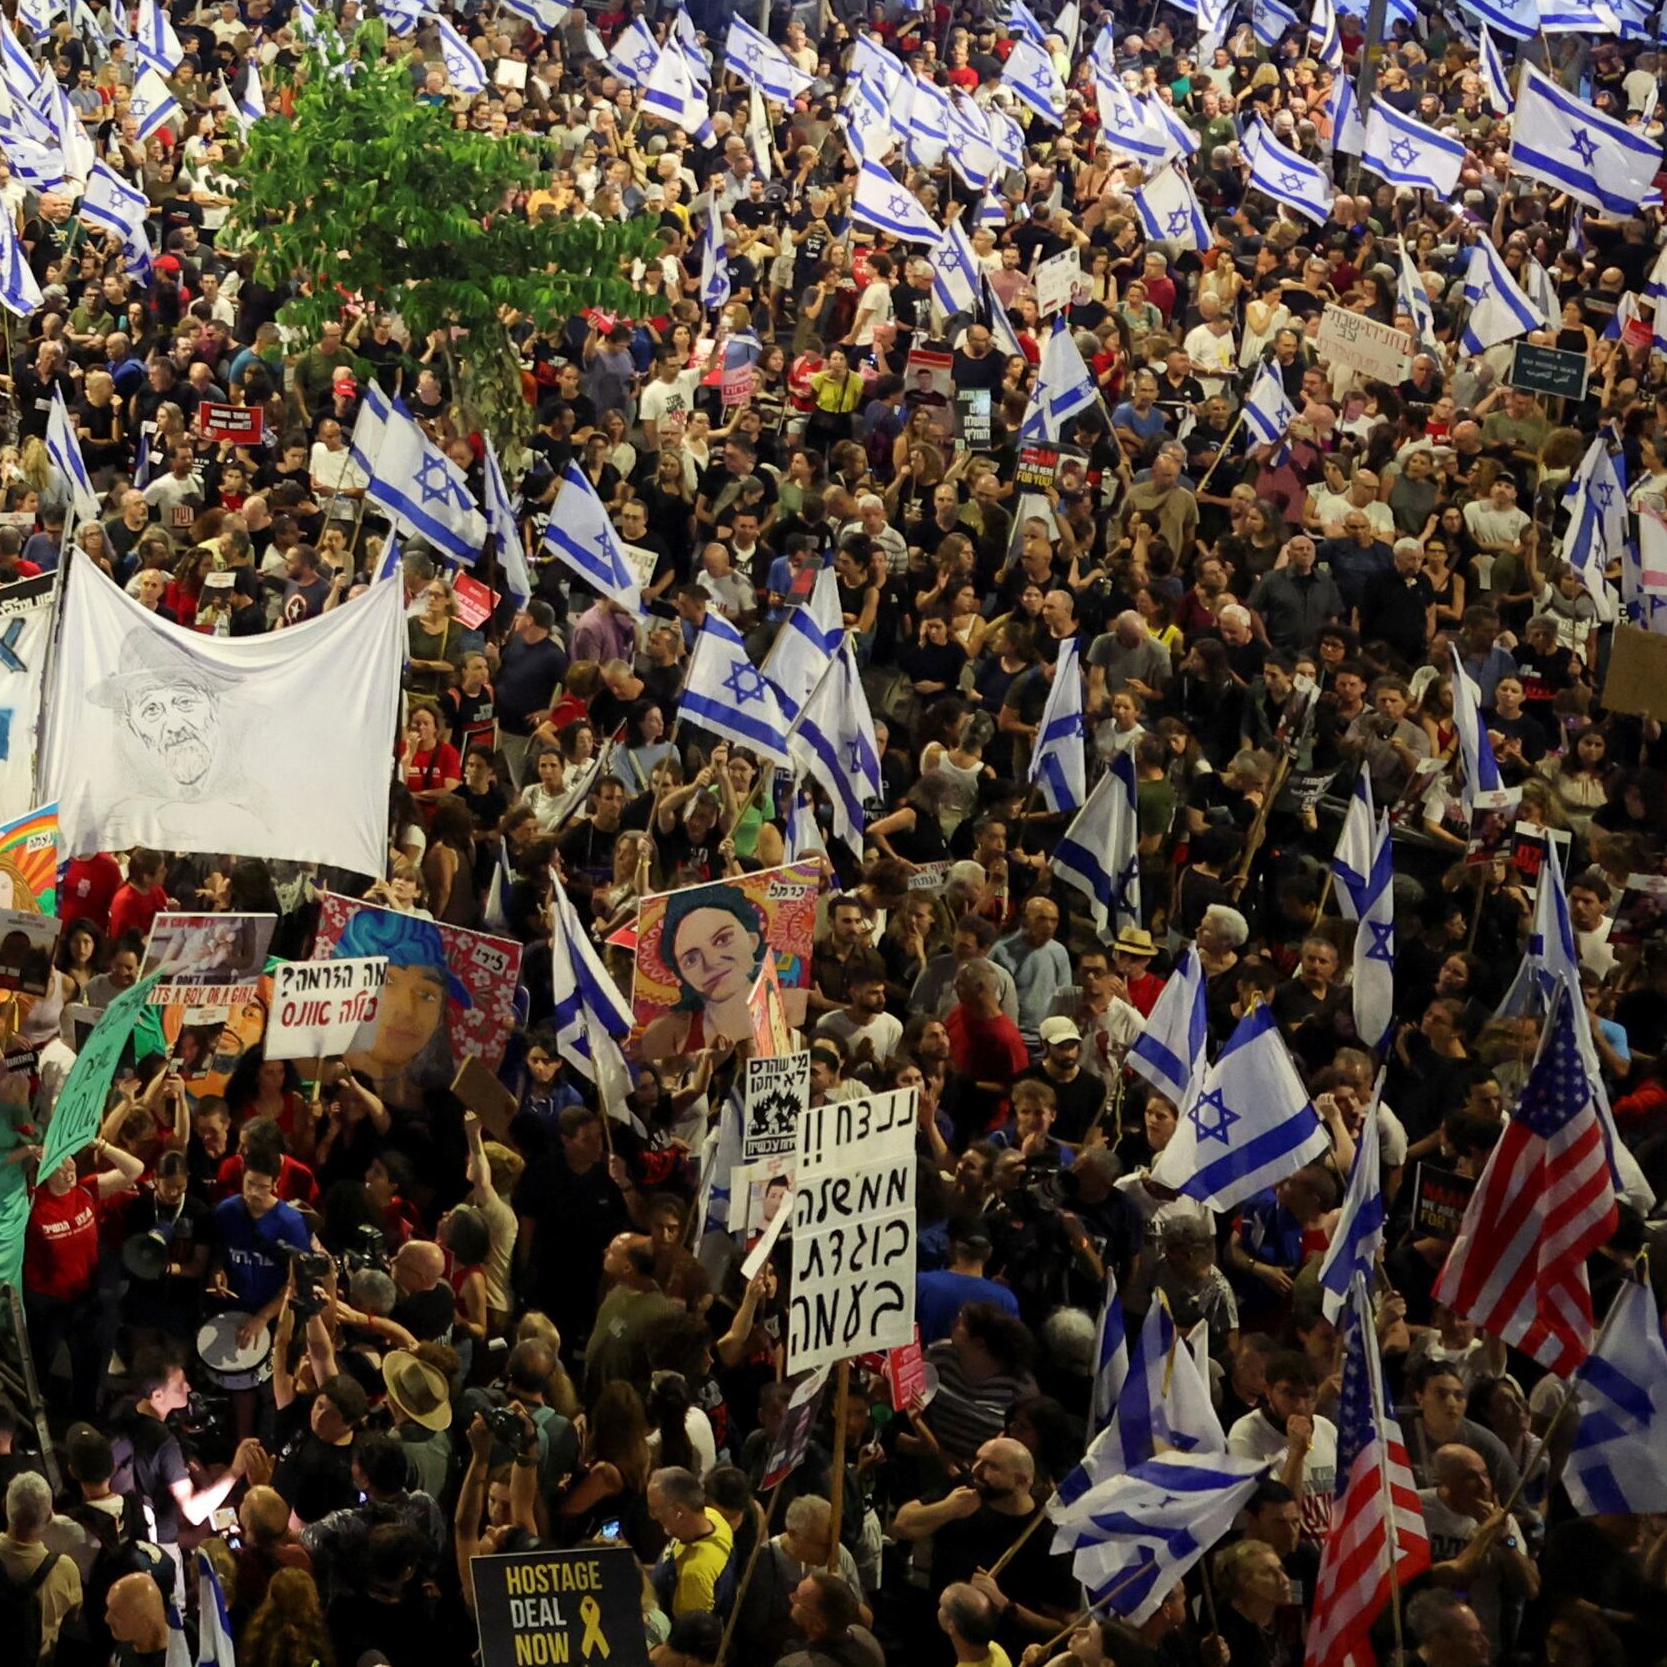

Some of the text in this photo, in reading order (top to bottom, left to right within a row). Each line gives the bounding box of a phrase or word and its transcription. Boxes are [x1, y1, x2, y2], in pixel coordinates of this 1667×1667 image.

[769, 882, 805, 898] כרמל
[477, 948, 505, 972] לירי
[183, 986, 205, 1003] BOY
[338, 990, 379, 1024] כולה
[750, 1053, 808, 1075] מי שהרס
[749, 1072, 807, 1094] לא יתקן
[795, 1166, 909, 1227] ממשלה
[797, 1220, 909, 1282] בוגדת
[791, 1279, 906, 1358] בעמה
[506, 1561, 603, 1595] HOSTAGE
[510, 1596, 569, 1628] DEAL
[514, 1631, 571, 1666] NOW
